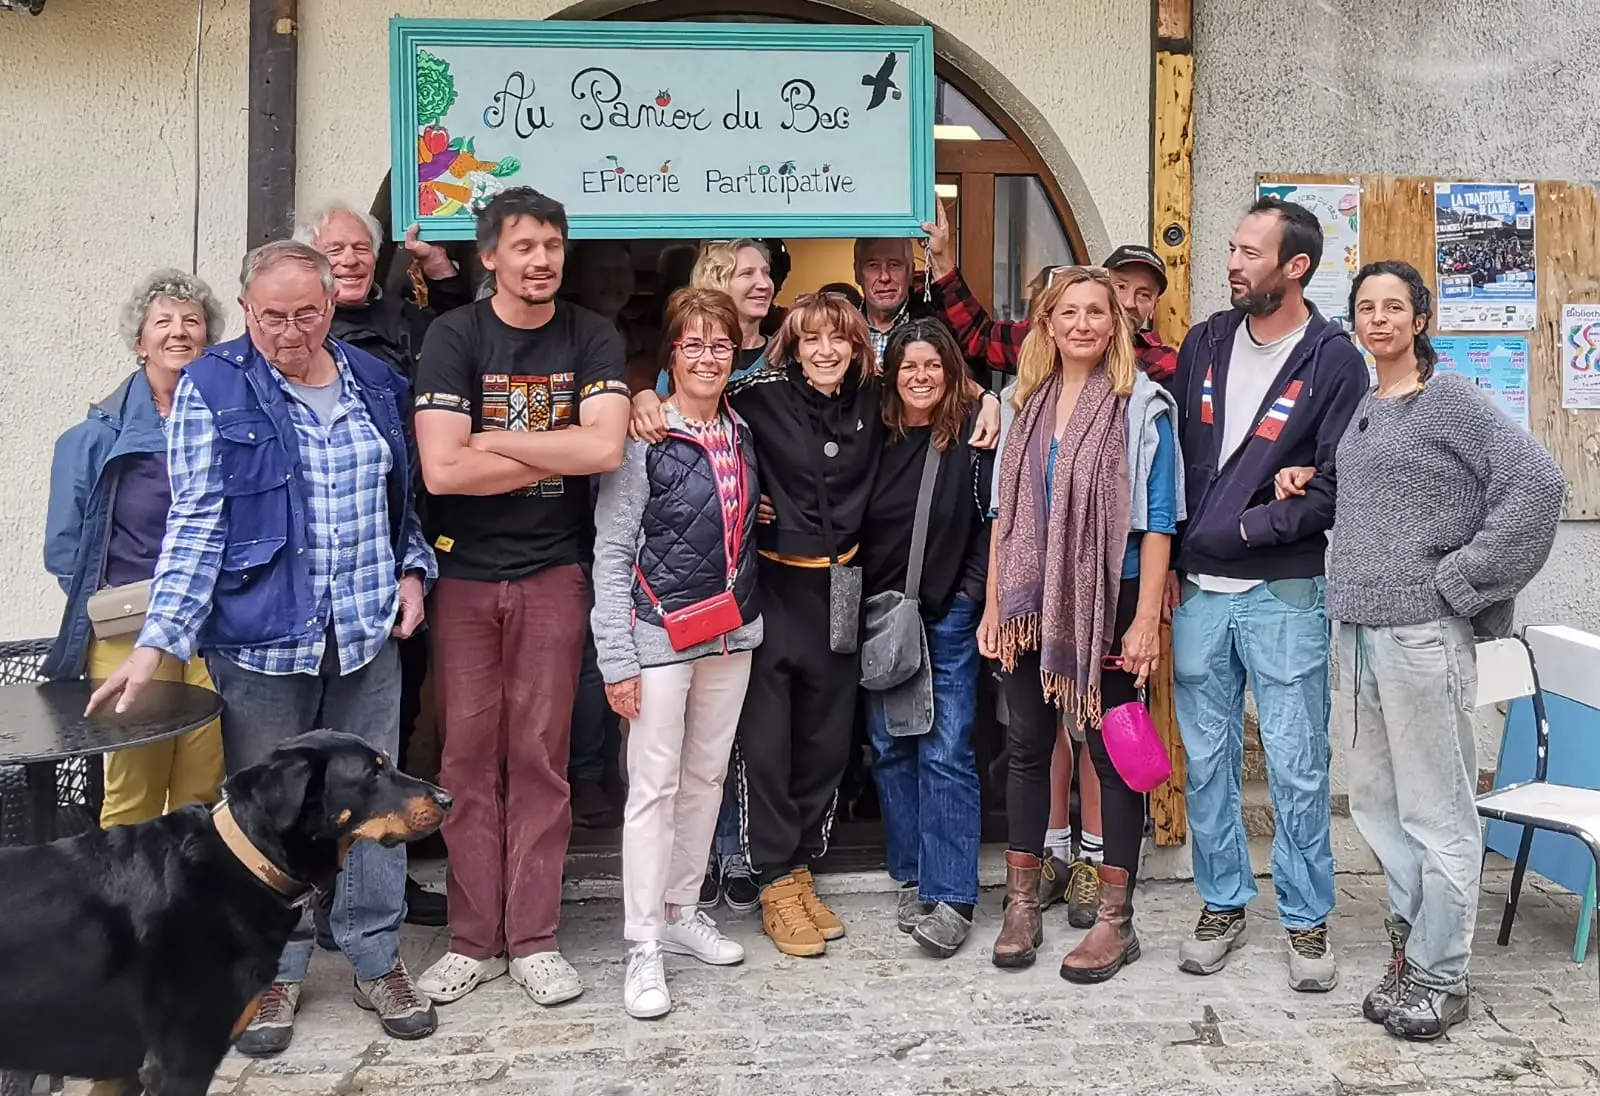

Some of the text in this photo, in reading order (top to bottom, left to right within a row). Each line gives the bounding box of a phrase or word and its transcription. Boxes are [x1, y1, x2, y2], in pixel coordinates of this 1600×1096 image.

[484, 67, 850, 139] Au Panier du Bec
[706, 165, 857, 204] Participative
